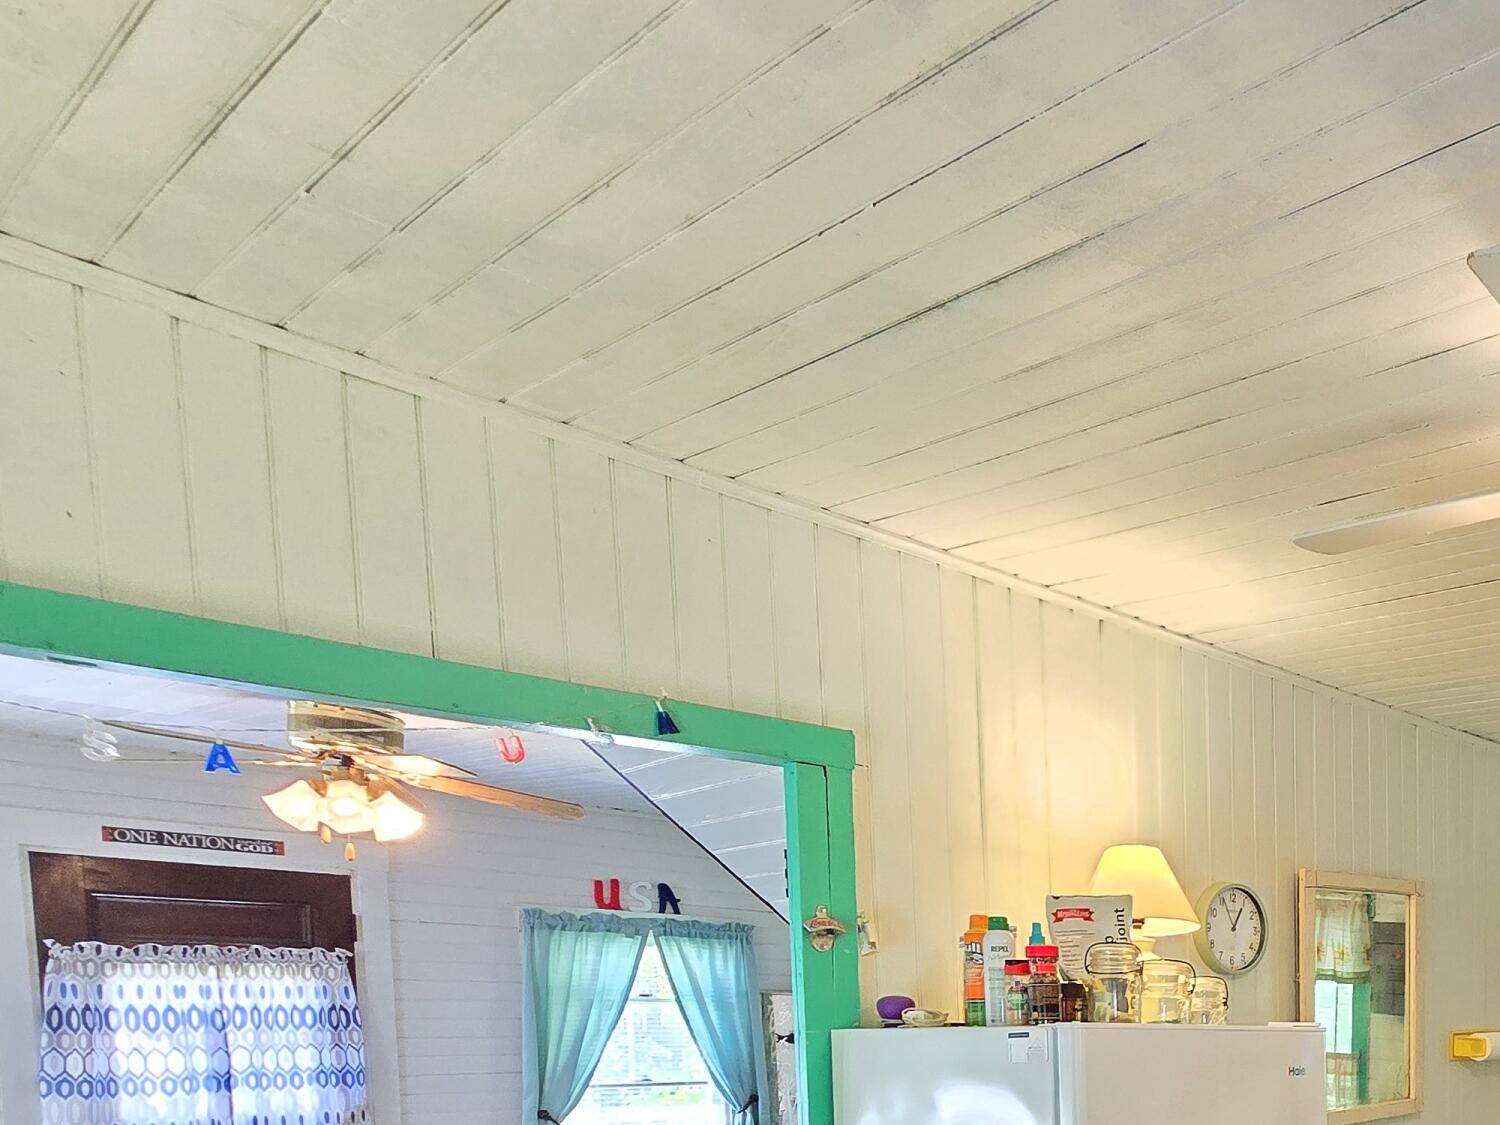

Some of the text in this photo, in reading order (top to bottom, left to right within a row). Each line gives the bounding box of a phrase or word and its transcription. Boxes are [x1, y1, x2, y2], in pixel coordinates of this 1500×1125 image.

[204, 742, 242, 775] A
[495, 734, 526, 766] U
[114, 828, 235, 850] ONE NATION
[235, 843, 274, 853] GOD
[1113, 907, 1128, 943] joint
